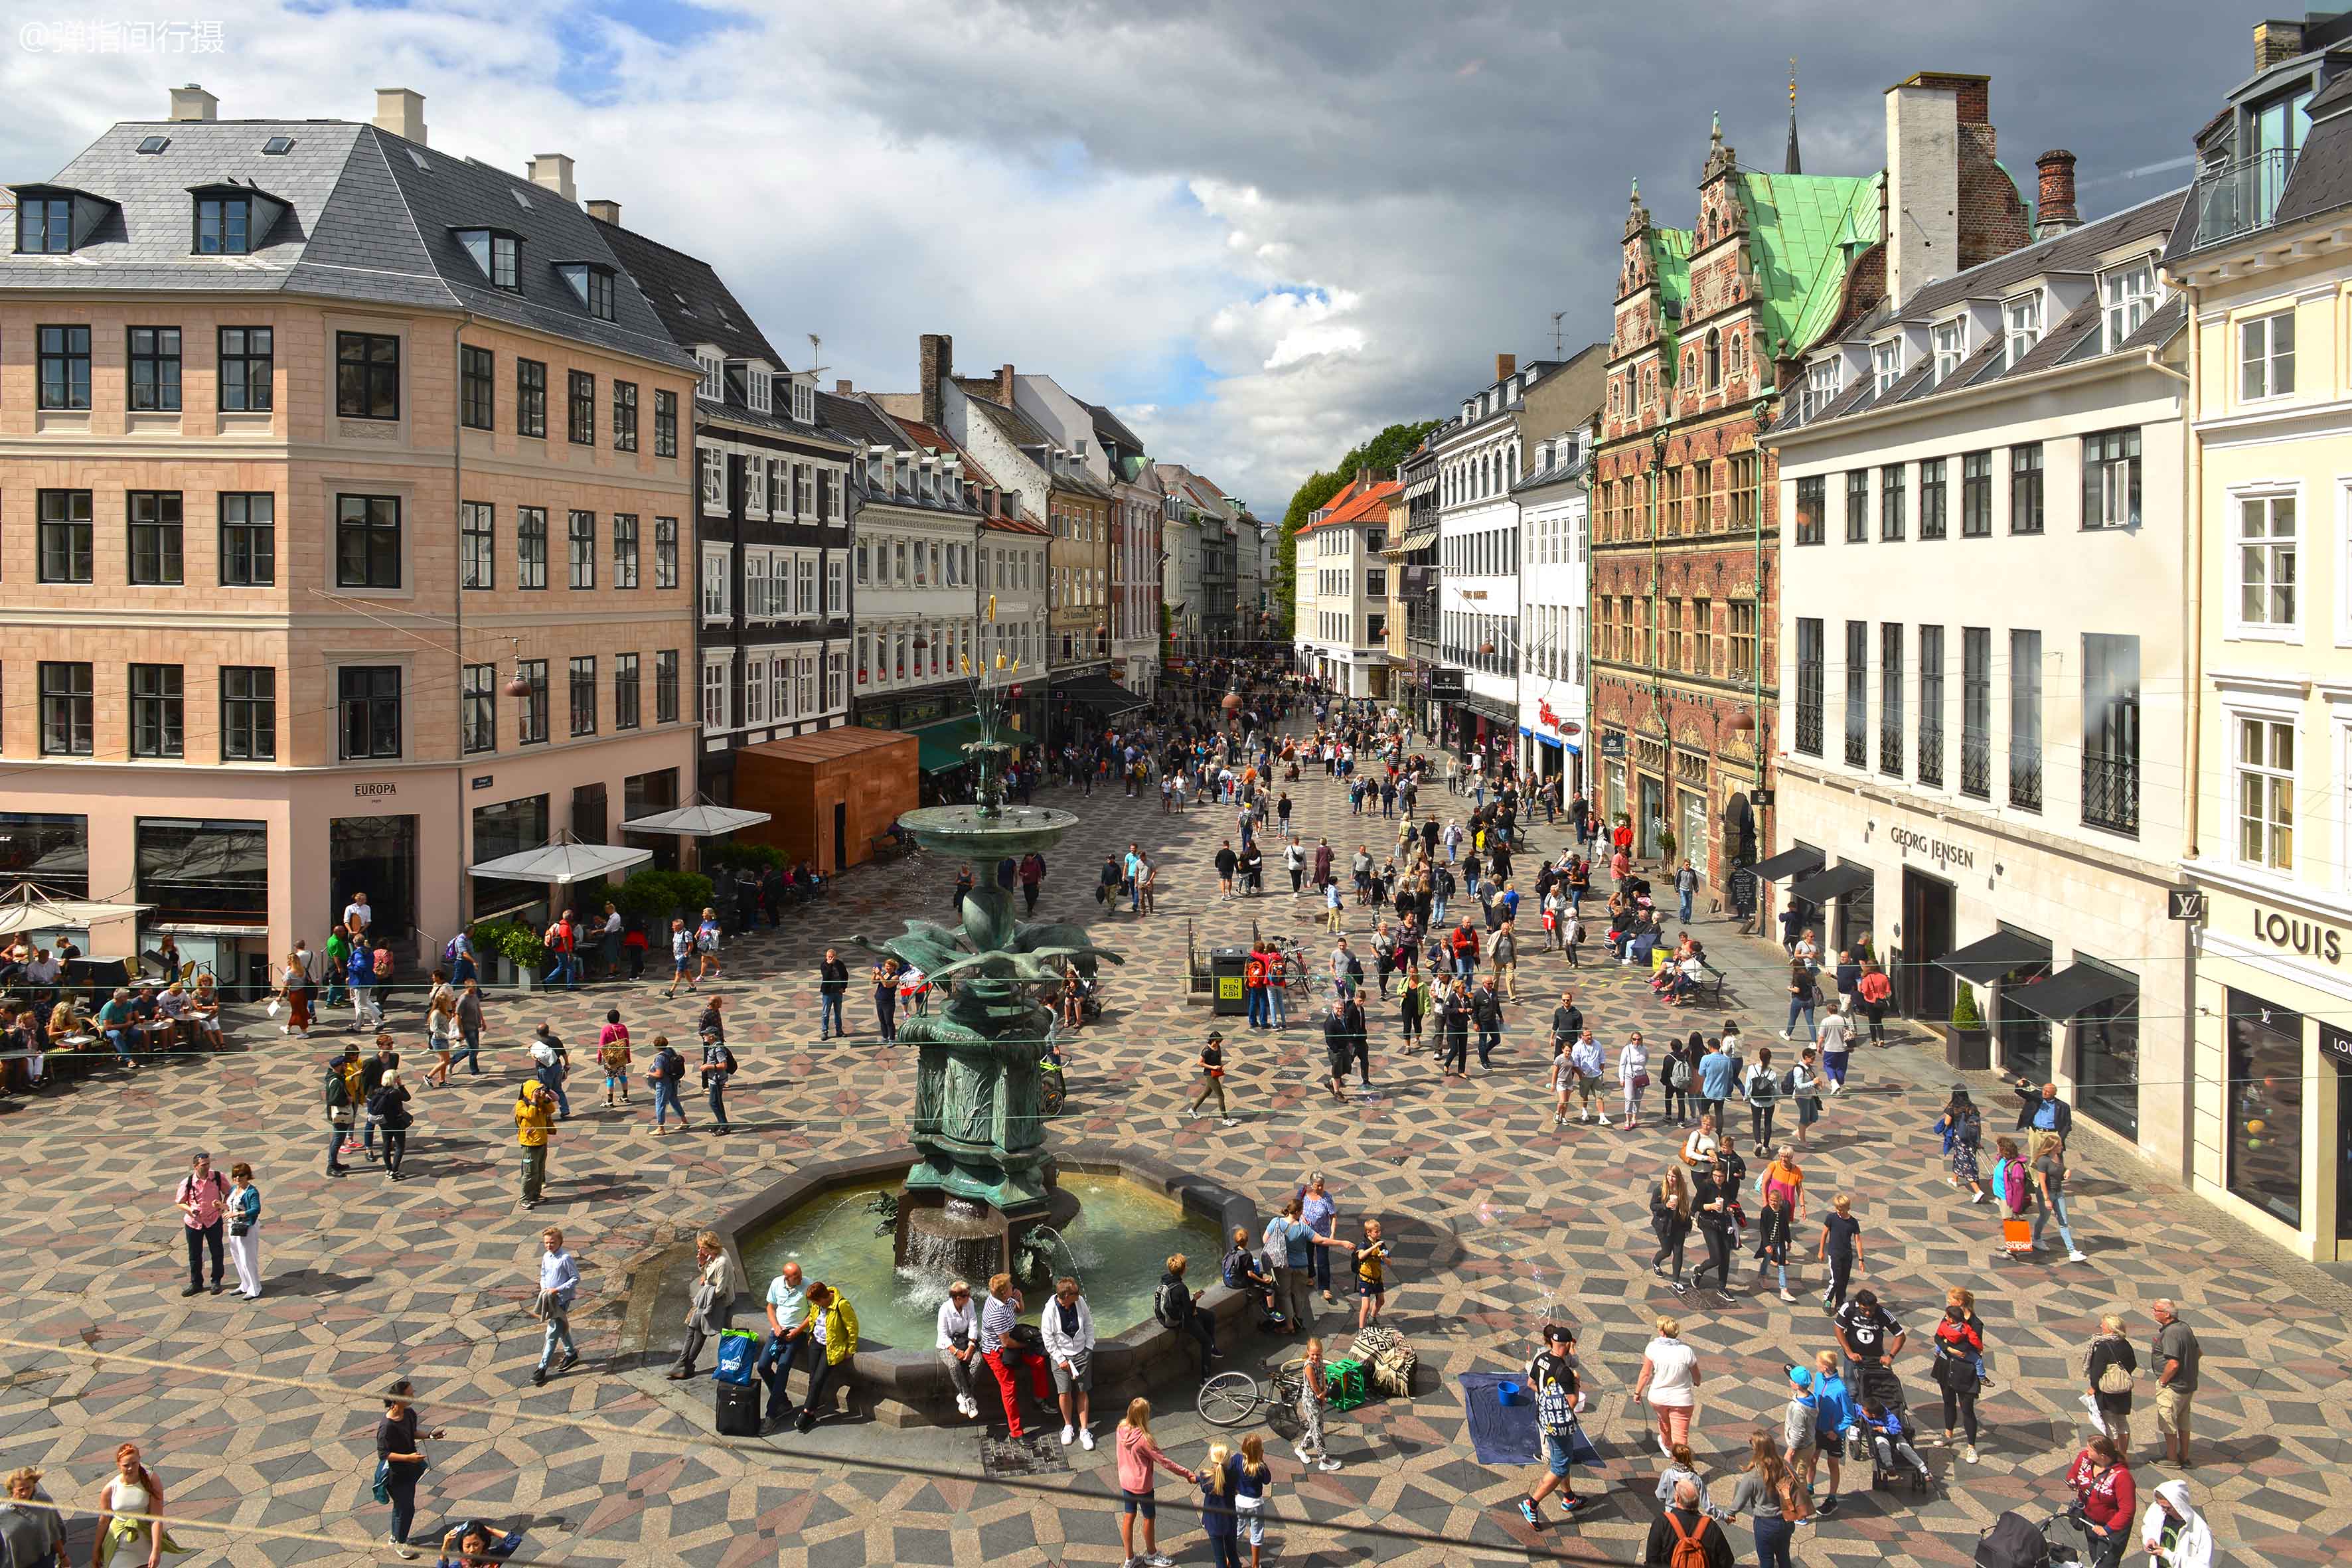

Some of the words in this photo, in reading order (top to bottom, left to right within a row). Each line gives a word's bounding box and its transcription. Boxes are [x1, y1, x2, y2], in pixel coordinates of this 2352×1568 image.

[354, 783, 397, 795] EUROPA
[1891, 826, 1927, 853] GEORG
[1931, 838, 1974, 870] JENSEN
[2254, 908, 2341, 964] LOUIS
